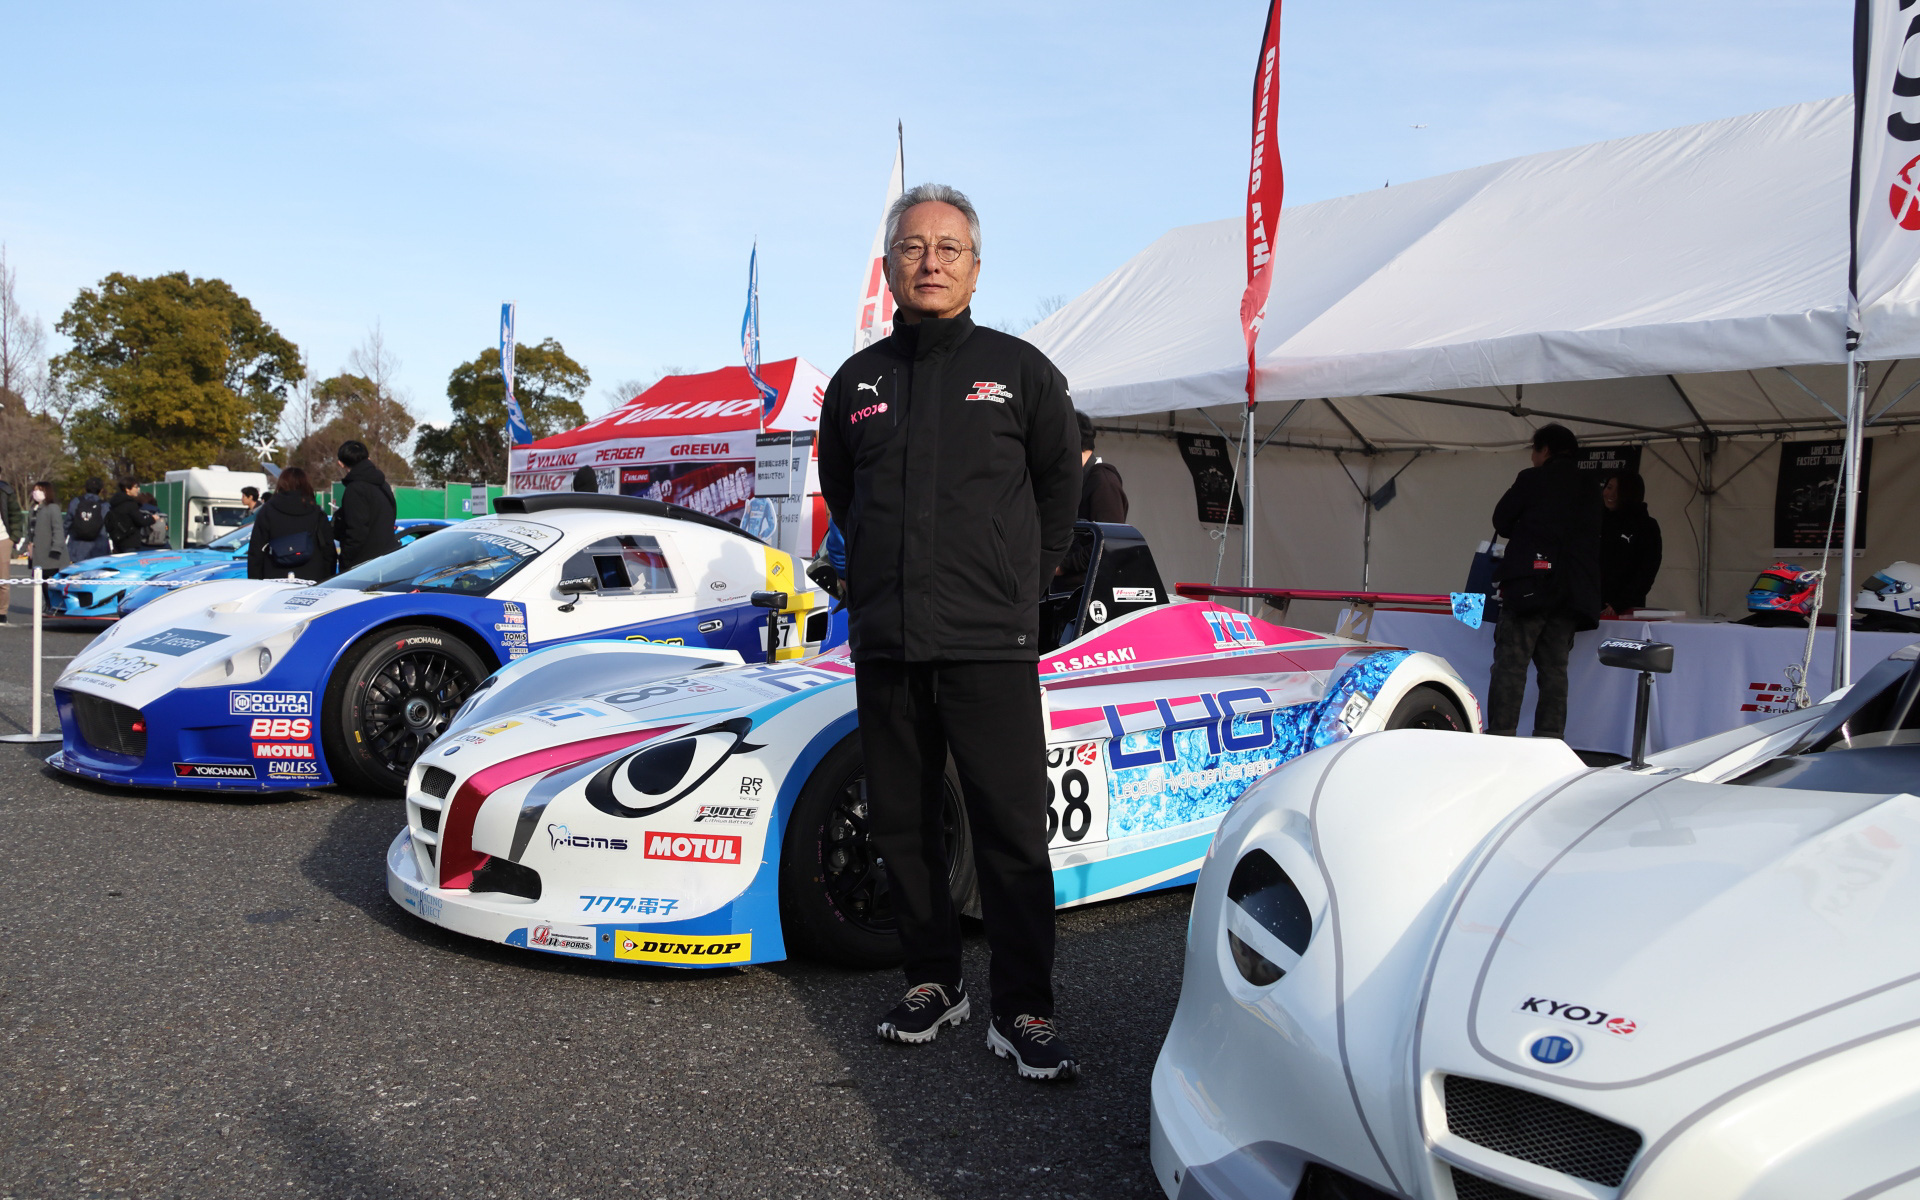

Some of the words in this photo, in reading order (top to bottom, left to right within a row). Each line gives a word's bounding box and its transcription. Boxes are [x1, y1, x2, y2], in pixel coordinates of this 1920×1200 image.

[614, 399, 757, 426] VALINO
[538, 453, 577, 466] VALINO
[596, 447, 645, 461] PERGER
[671, 443, 730, 456] GREEVA
[1202, 611, 1258, 643] YLT
[406, 638, 442, 646] YOKOHAMA
[1052, 647, 1137, 673] R.SASAKI
[252, 694, 308, 704] OGURA
[252, 703, 308, 713] CLUTCH
[250, 718, 312, 740] BBS
[1102, 686, 1275, 771] LHG
[256, 744, 312, 758] MOTUL
[194, 766, 251, 777] YOKOHAMA
[268, 761, 317, 774] ENDLESS
[1222, 757, 1278, 781] Generator
[648, 836, 737, 860] MOTUL
[579, 895, 679, 916] フクダ電子
[640, 941, 741, 955] DUNLOP
